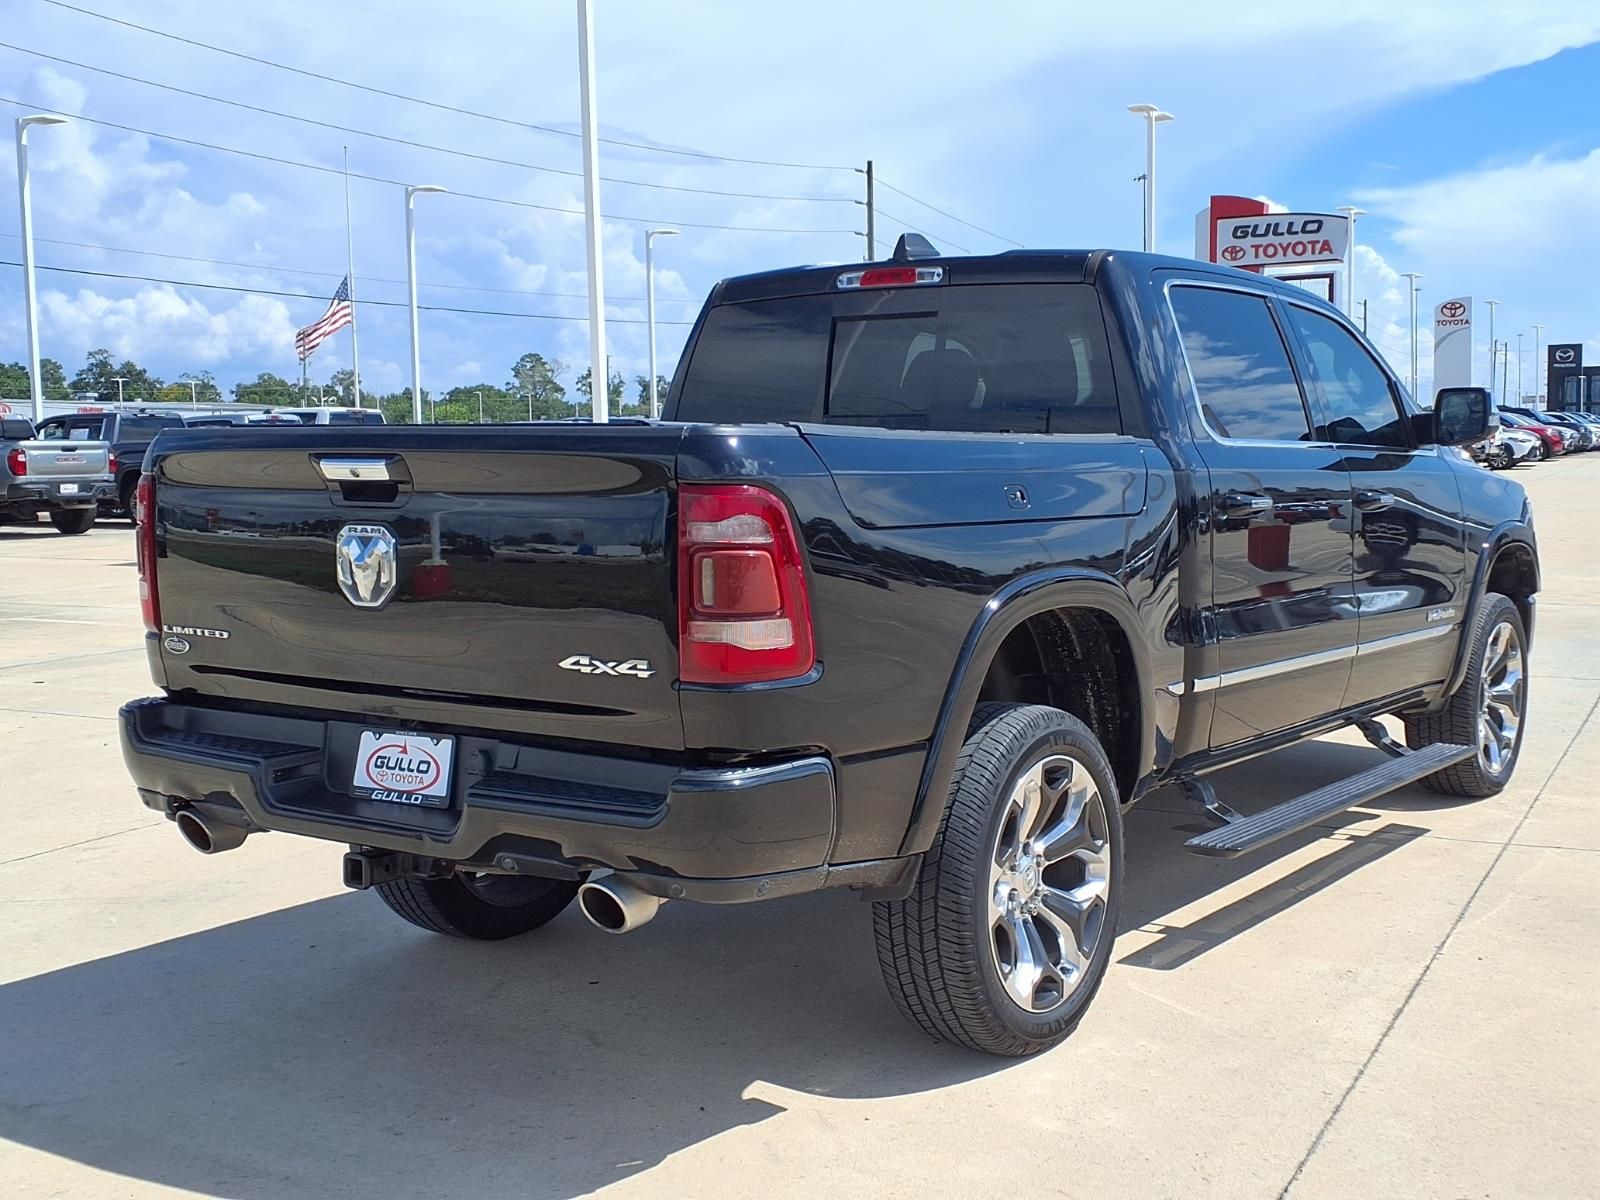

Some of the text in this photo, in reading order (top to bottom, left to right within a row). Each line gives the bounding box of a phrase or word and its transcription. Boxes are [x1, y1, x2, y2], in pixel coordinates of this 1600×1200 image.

[1231, 219, 1324, 239] GULLO
[1250, 239, 1333, 259] TOYOTA
[1436, 319, 1471, 327] TOYOTA
[348, 527, 382, 535] RAM
[163, 624, 231, 639] LIMITED
[374, 755, 431, 774] GULLO
[390, 773, 425, 785] TOYOTA
[371, 790, 422, 804] GULLO
